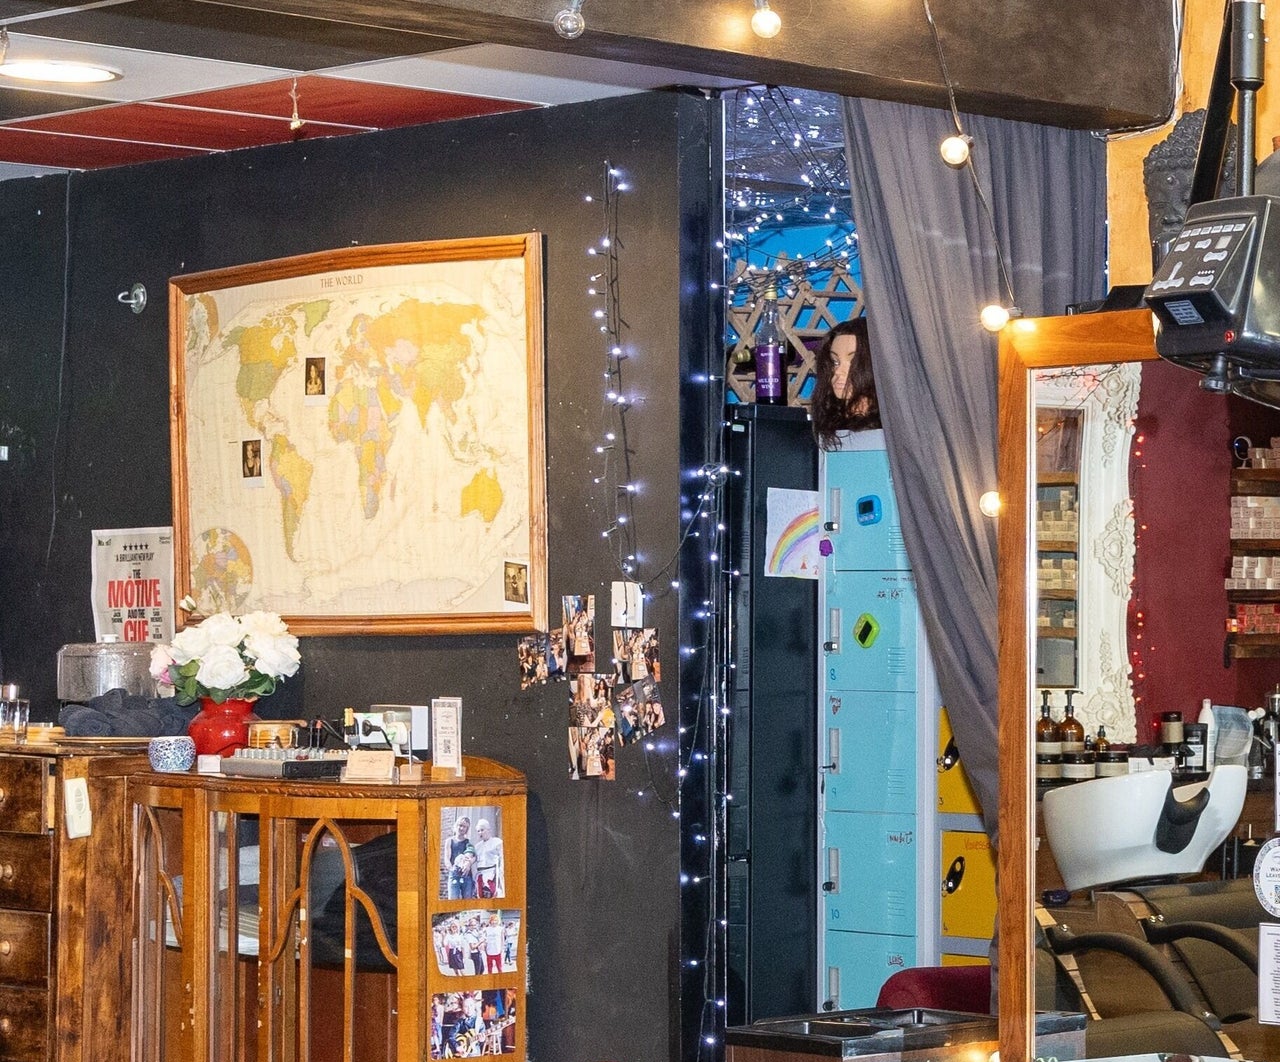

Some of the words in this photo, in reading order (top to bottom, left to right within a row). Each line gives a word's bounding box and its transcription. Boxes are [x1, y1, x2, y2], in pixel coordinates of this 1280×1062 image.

[320, 278, 334, 289] THE
[335, 274, 364, 287] WORLD
[132, 568, 142, 579] THE
[107, 578, 162, 608] MOTIVE
